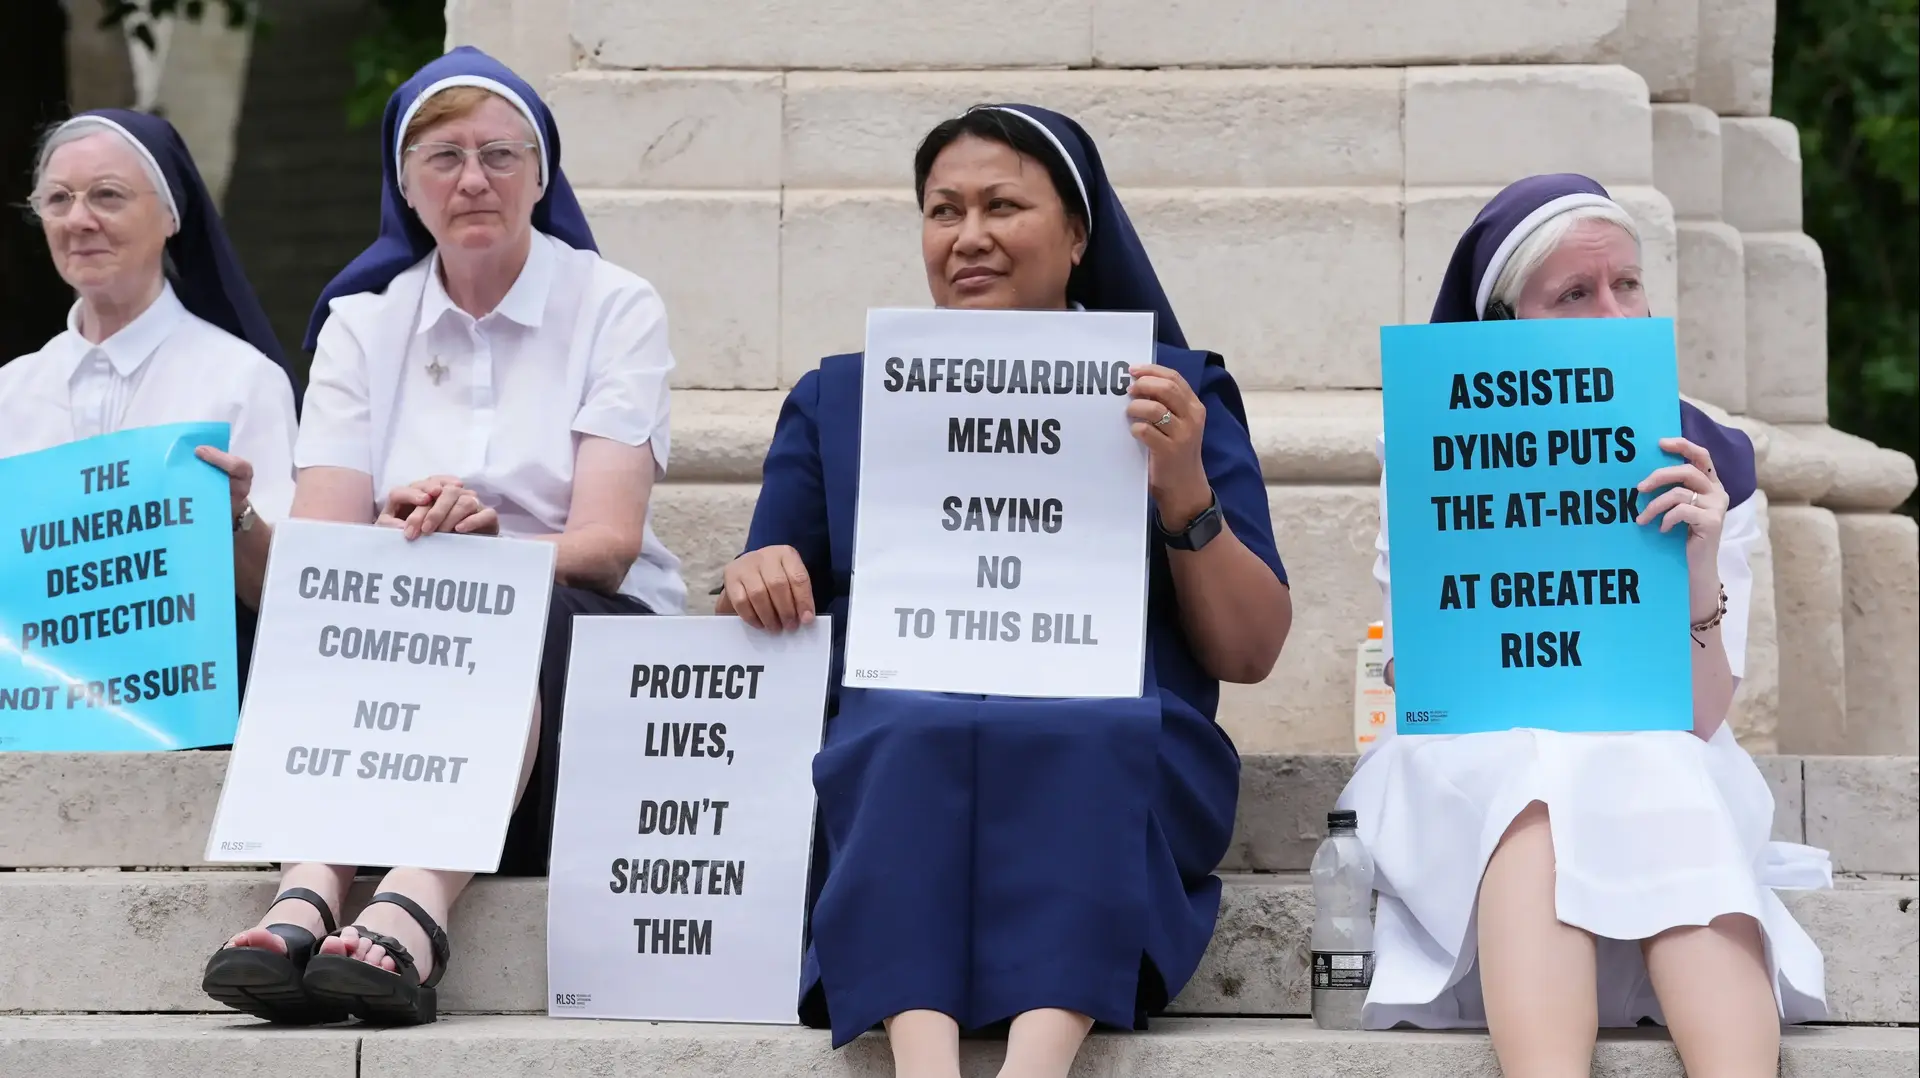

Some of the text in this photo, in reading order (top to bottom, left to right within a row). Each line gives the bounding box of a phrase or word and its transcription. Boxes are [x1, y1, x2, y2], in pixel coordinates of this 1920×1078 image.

[884, 357, 1130, 396] SAFEGUARDING
[1449, 368, 1615, 410] ASSISTED
[948, 418, 1060, 454] MEANS
[1432, 426, 1636, 472] DYING PUTS
[80, 460, 130, 495] THE
[20, 497, 194, 554] VULNERABLE
[942, 496, 1063, 533] SAYING
[1431, 488, 1639, 531] THE AT-RISK
[46, 549, 168, 598] DESERVE
[298, 566, 516, 616] CARE SHOULD
[977, 556, 1022, 589] NO
[1440, 569, 1640, 610] AT GREATER
[22, 594, 195, 652] PROTECTION
[895, 608, 1098, 645] TO THIS BILL
[318, 625, 476, 675] COMFORT,
[1501, 631, 1583, 668] RISK
[0, 661, 217, 711] NOT PRESSURE
[630, 664, 764, 700] PROTECT
[855, 669, 879, 679] RLSS
[354, 700, 420, 732] NOT
[1406, 711, 1429, 722] RLSS
[645, 723, 734, 765] LIVES,
[286, 746, 468, 784] CUT SHORT
[638, 798, 729, 836] DON'T
[221, 841, 244, 851] RLSS
[610, 858, 745, 896] SHORTEN
[634, 919, 713, 956] THEM
[556, 993, 576, 1004] RLSS
